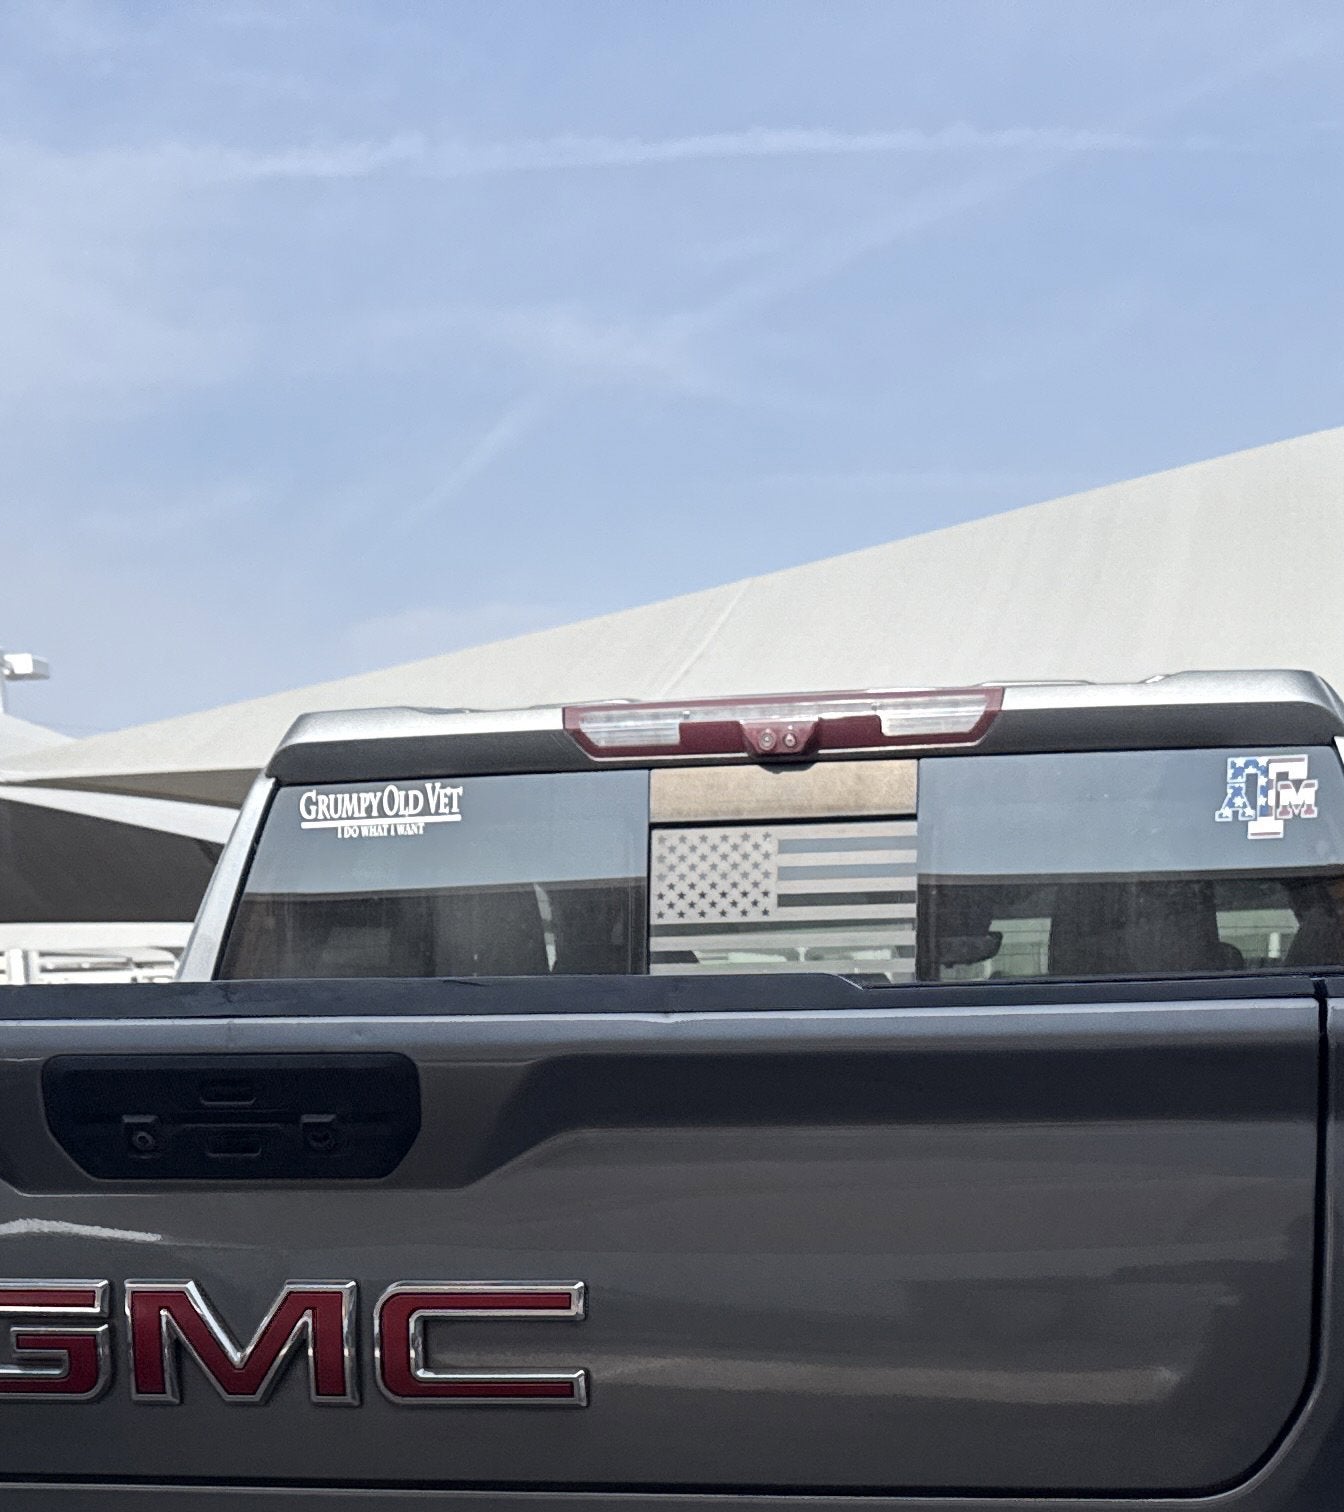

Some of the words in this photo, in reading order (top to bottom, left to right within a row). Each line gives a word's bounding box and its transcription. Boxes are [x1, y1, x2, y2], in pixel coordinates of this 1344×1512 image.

[299, 789, 382, 820] GRUMPY
[382, 784, 424, 816] OLD
[424, 782, 464, 814] VET
[337, 825, 343, 839] I
[343, 825, 360, 838] DO
[360, 824, 389, 837] WHAT
[396, 822, 426, 836] WANT
